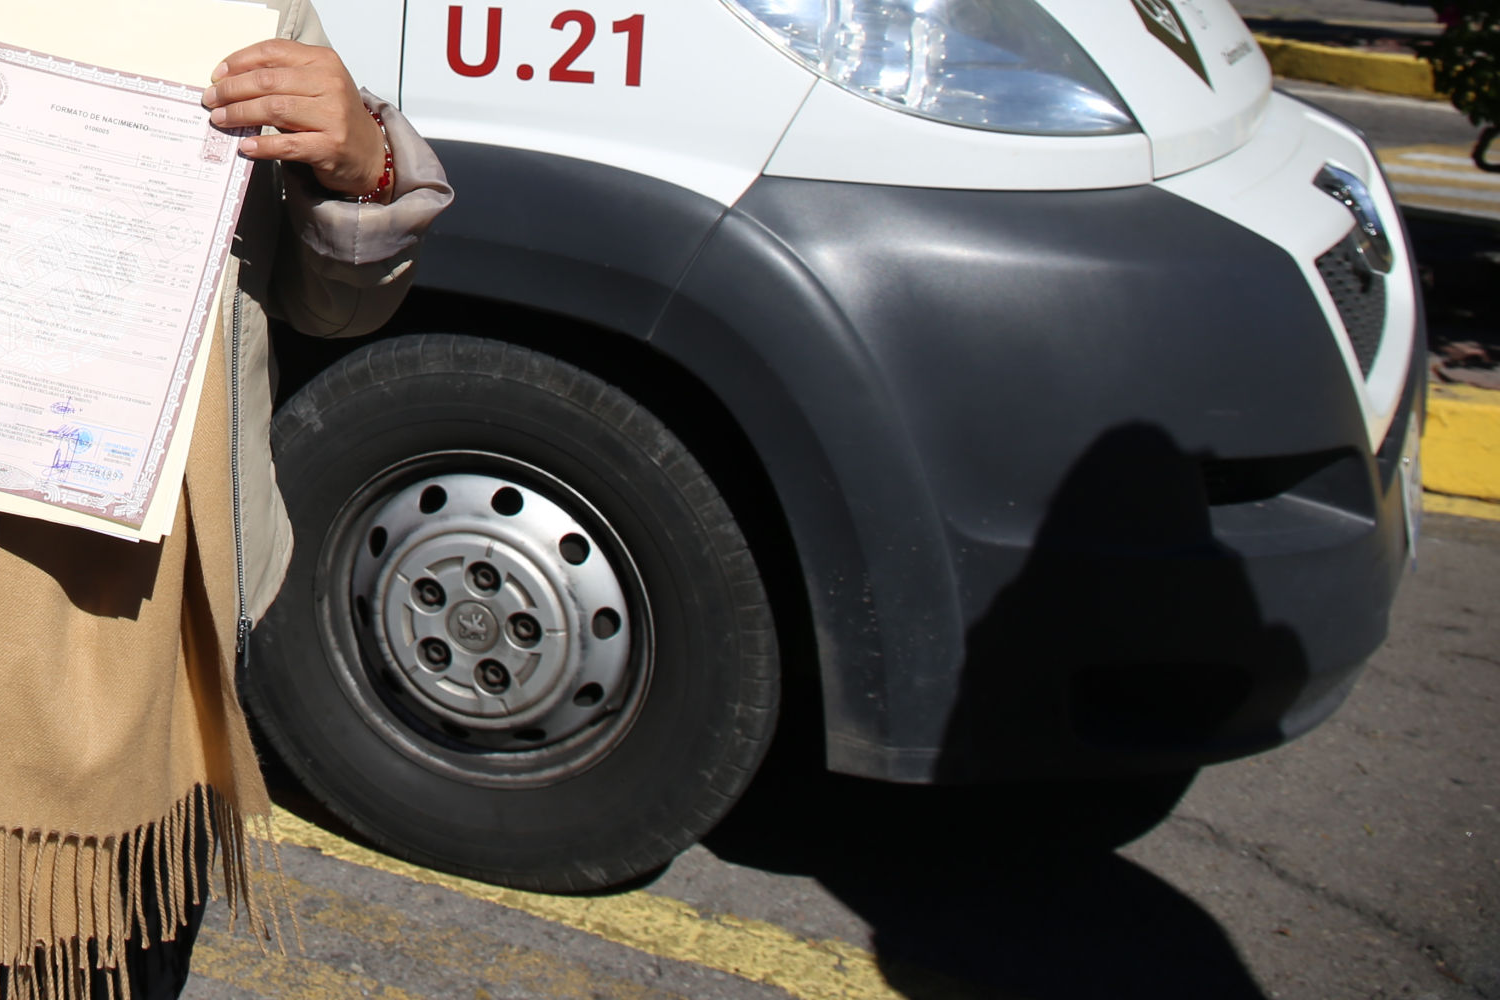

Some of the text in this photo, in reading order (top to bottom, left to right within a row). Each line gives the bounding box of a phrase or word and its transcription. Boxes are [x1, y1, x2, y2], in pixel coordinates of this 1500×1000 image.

[446, 4, 645, 88] U.21
[50, 103, 150, 131] FORMATO DE NACIMIENTO
